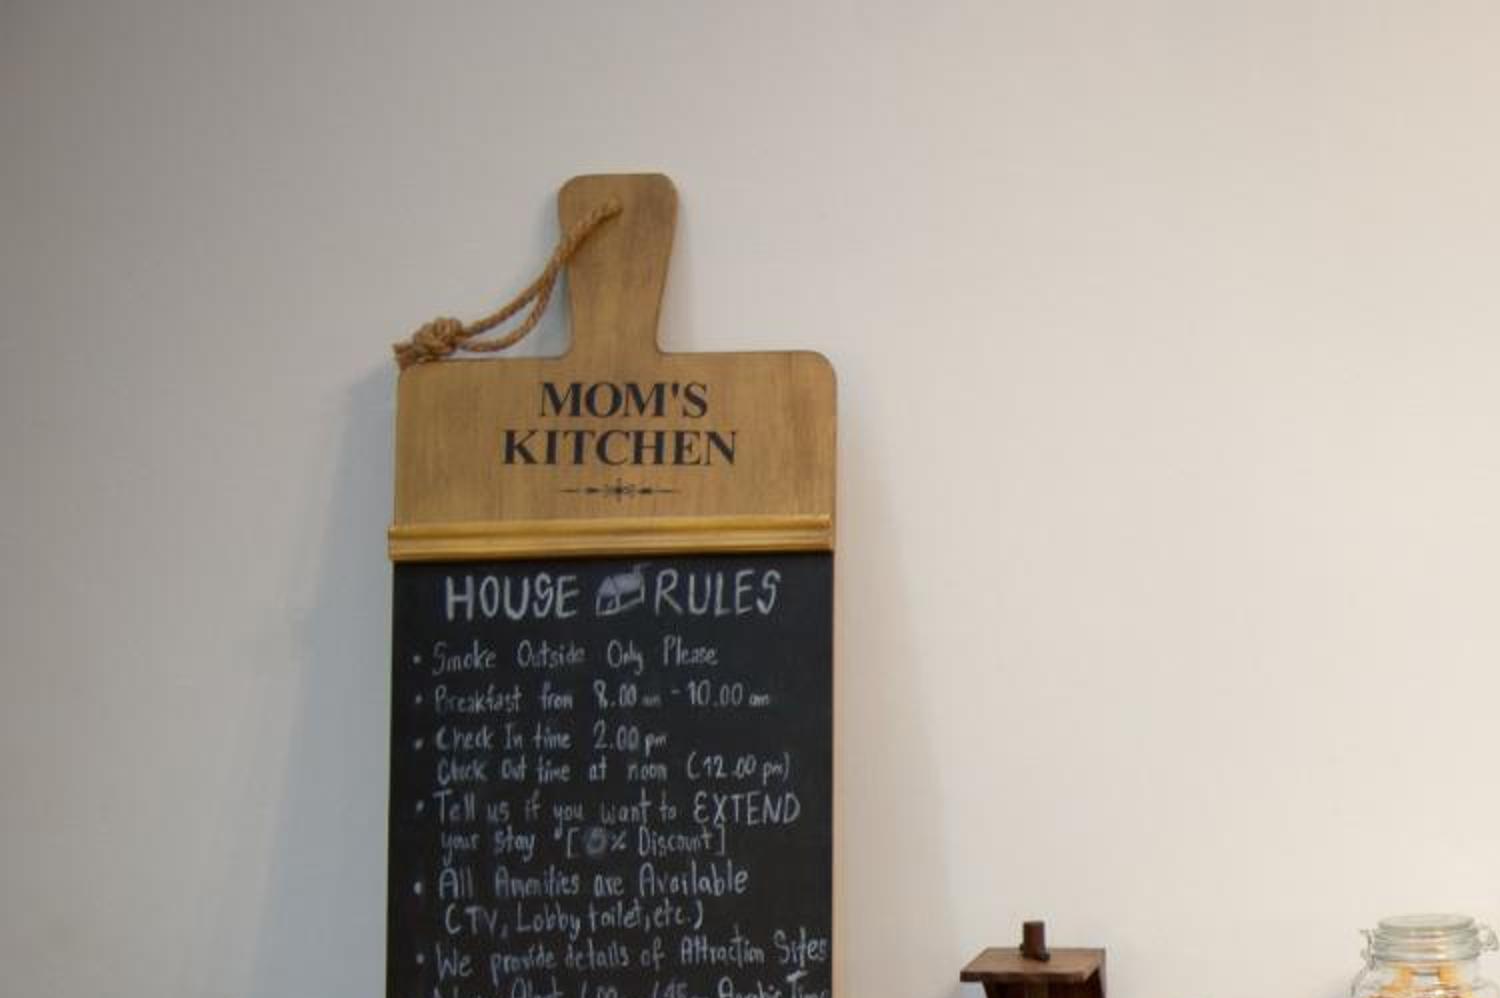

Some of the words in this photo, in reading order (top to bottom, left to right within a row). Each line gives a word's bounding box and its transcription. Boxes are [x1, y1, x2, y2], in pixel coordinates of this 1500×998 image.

[540, 382, 708, 418] MOM'S
[502, 430, 737, 466] KITCHEN
[445, 573, 579, 620] HOUSE
[654, 569, 781, 615] RULES
[432, 640, 496, 676] Smoke
[517, 639, 586, 669] Outside
[607, 639, 644, 675] Only
[663, 635, 718, 665] Please
[435, 684, 522, 713] Breakfast
[539, 680, 573, 711] from
[436, 725, 494, 752] Check
[504, 723, 523, 749] In
[534, 722, 571, 751] time
[536, 755, 571, 783] time
[589, 756, 608, 781] at
[628, 762, 667, 781] noon
[433, 789, 475, 823] Tell
[488, 800, 510, 822] us
[552, 801, 583, 839] you
[658, 790, 677, 822] to
[693, 790, 802, 826] EXTEND
[439, 868, 474, 898] All
[495, 865, 580, 898] Amenities
[594, 874, 624, 897] are
[639, 860, 750, 897] Available
[435, 942, 472, 982] We
[489, 944, 555, 988] provide
[564, 937, 629, 971] details
[641, 937, 665, 970] of
[681, 923, 765, 968] Attraction
[772, 926, 828, 968] Sites
